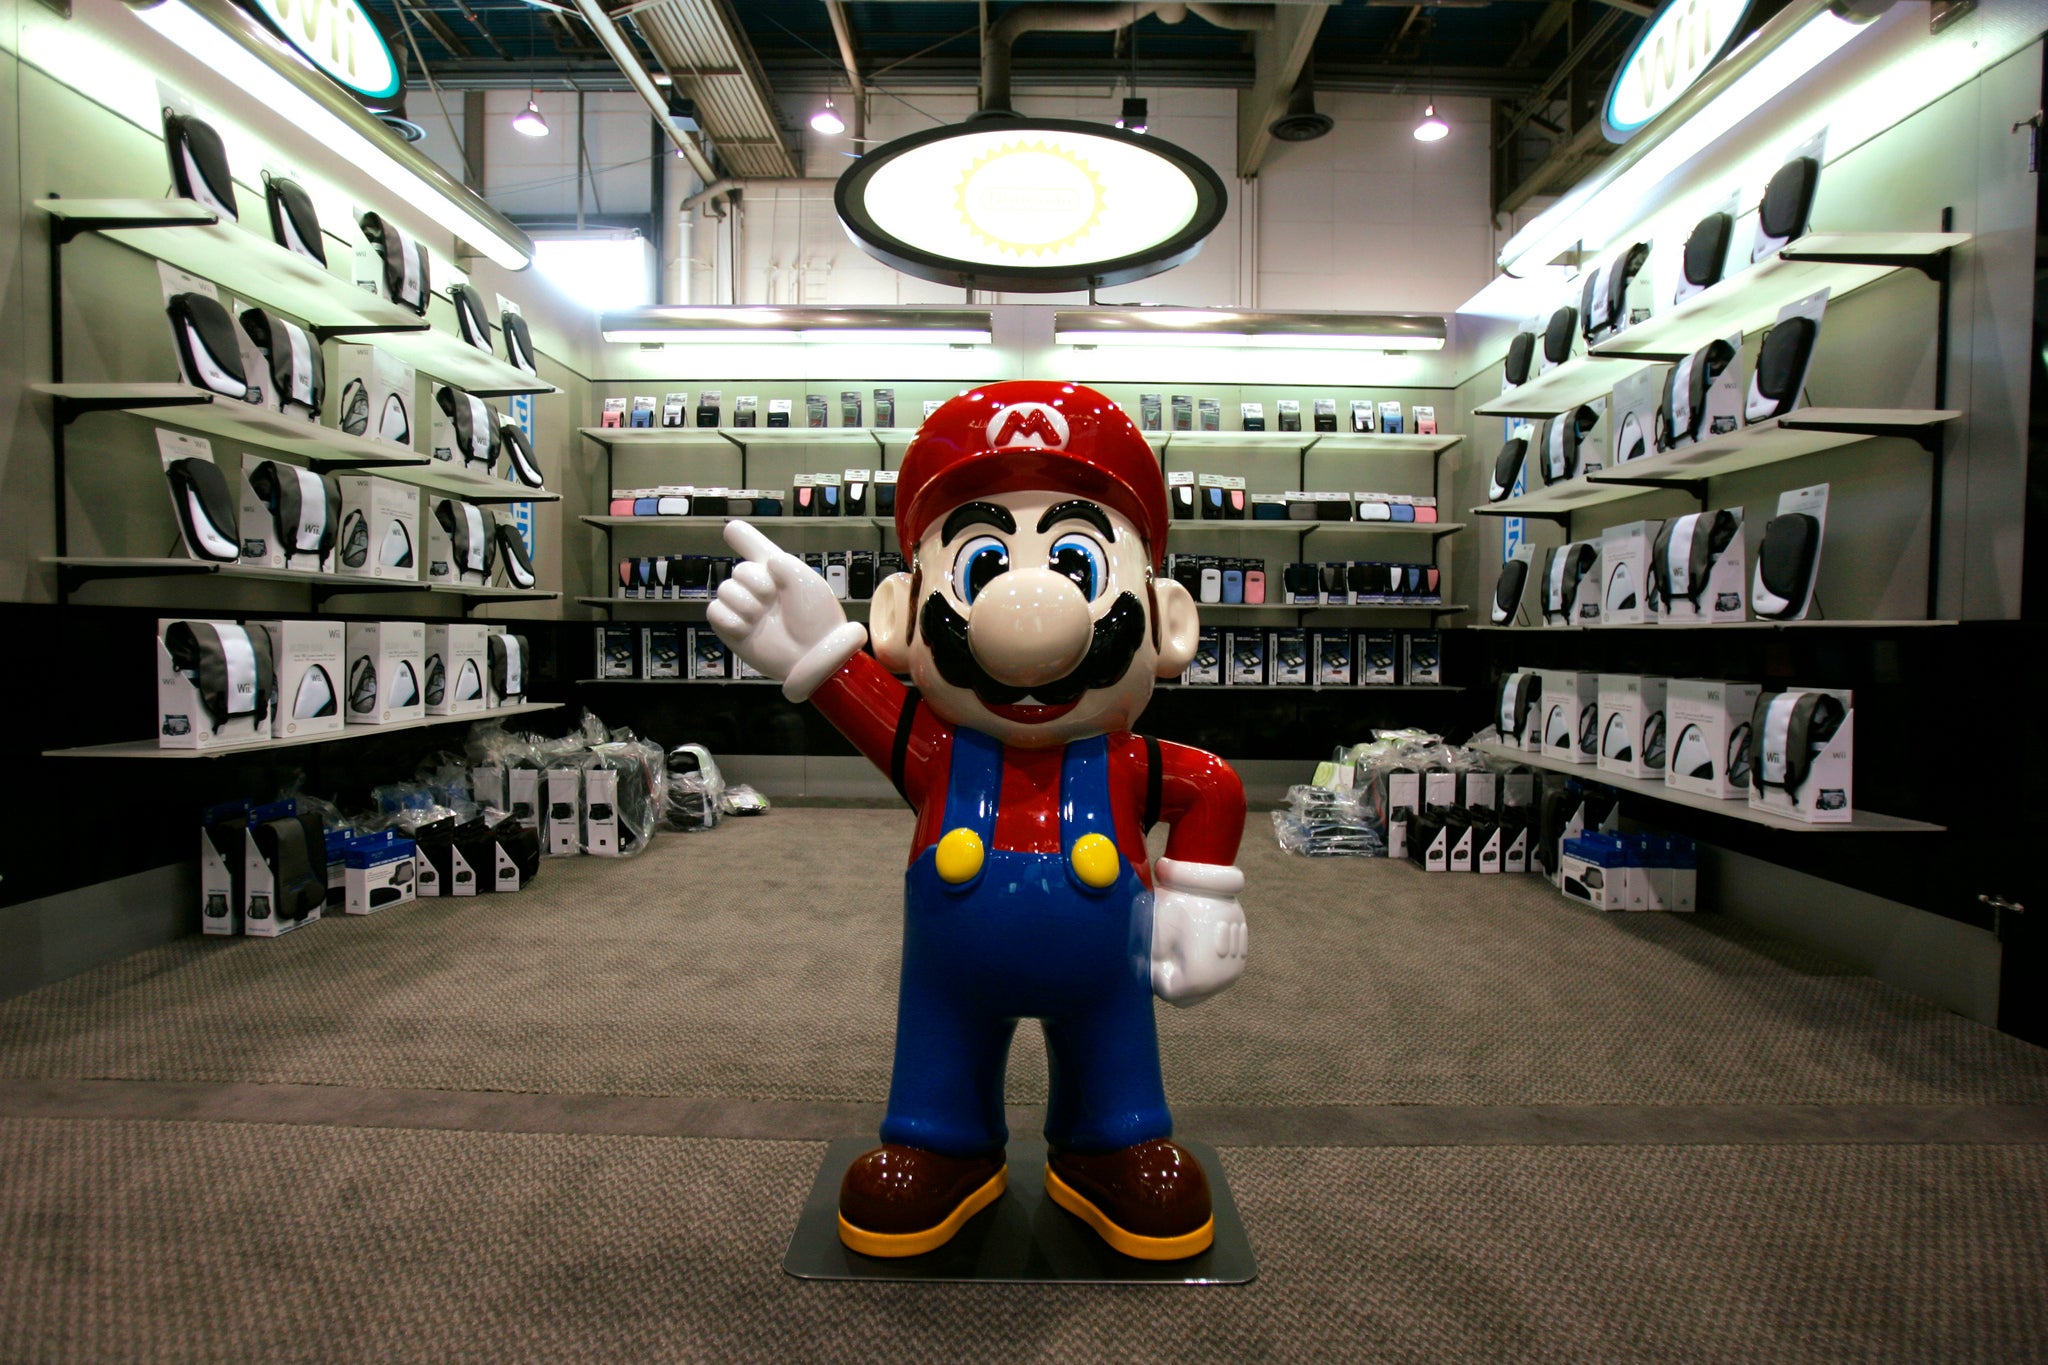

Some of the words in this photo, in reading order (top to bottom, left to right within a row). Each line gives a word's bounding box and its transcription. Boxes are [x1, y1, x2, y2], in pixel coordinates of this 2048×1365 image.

[993, 408, 1062, 446] M
[304, 523, 320, 535] Wii
[329, 630, 341, 639] Wii
[237, 683, 251, 694] Wii
[1707, 690, 1720, 701] Wii
[1689, 735, 1701, 743] Wii
[1766, 752, 1780, 763] Wii
